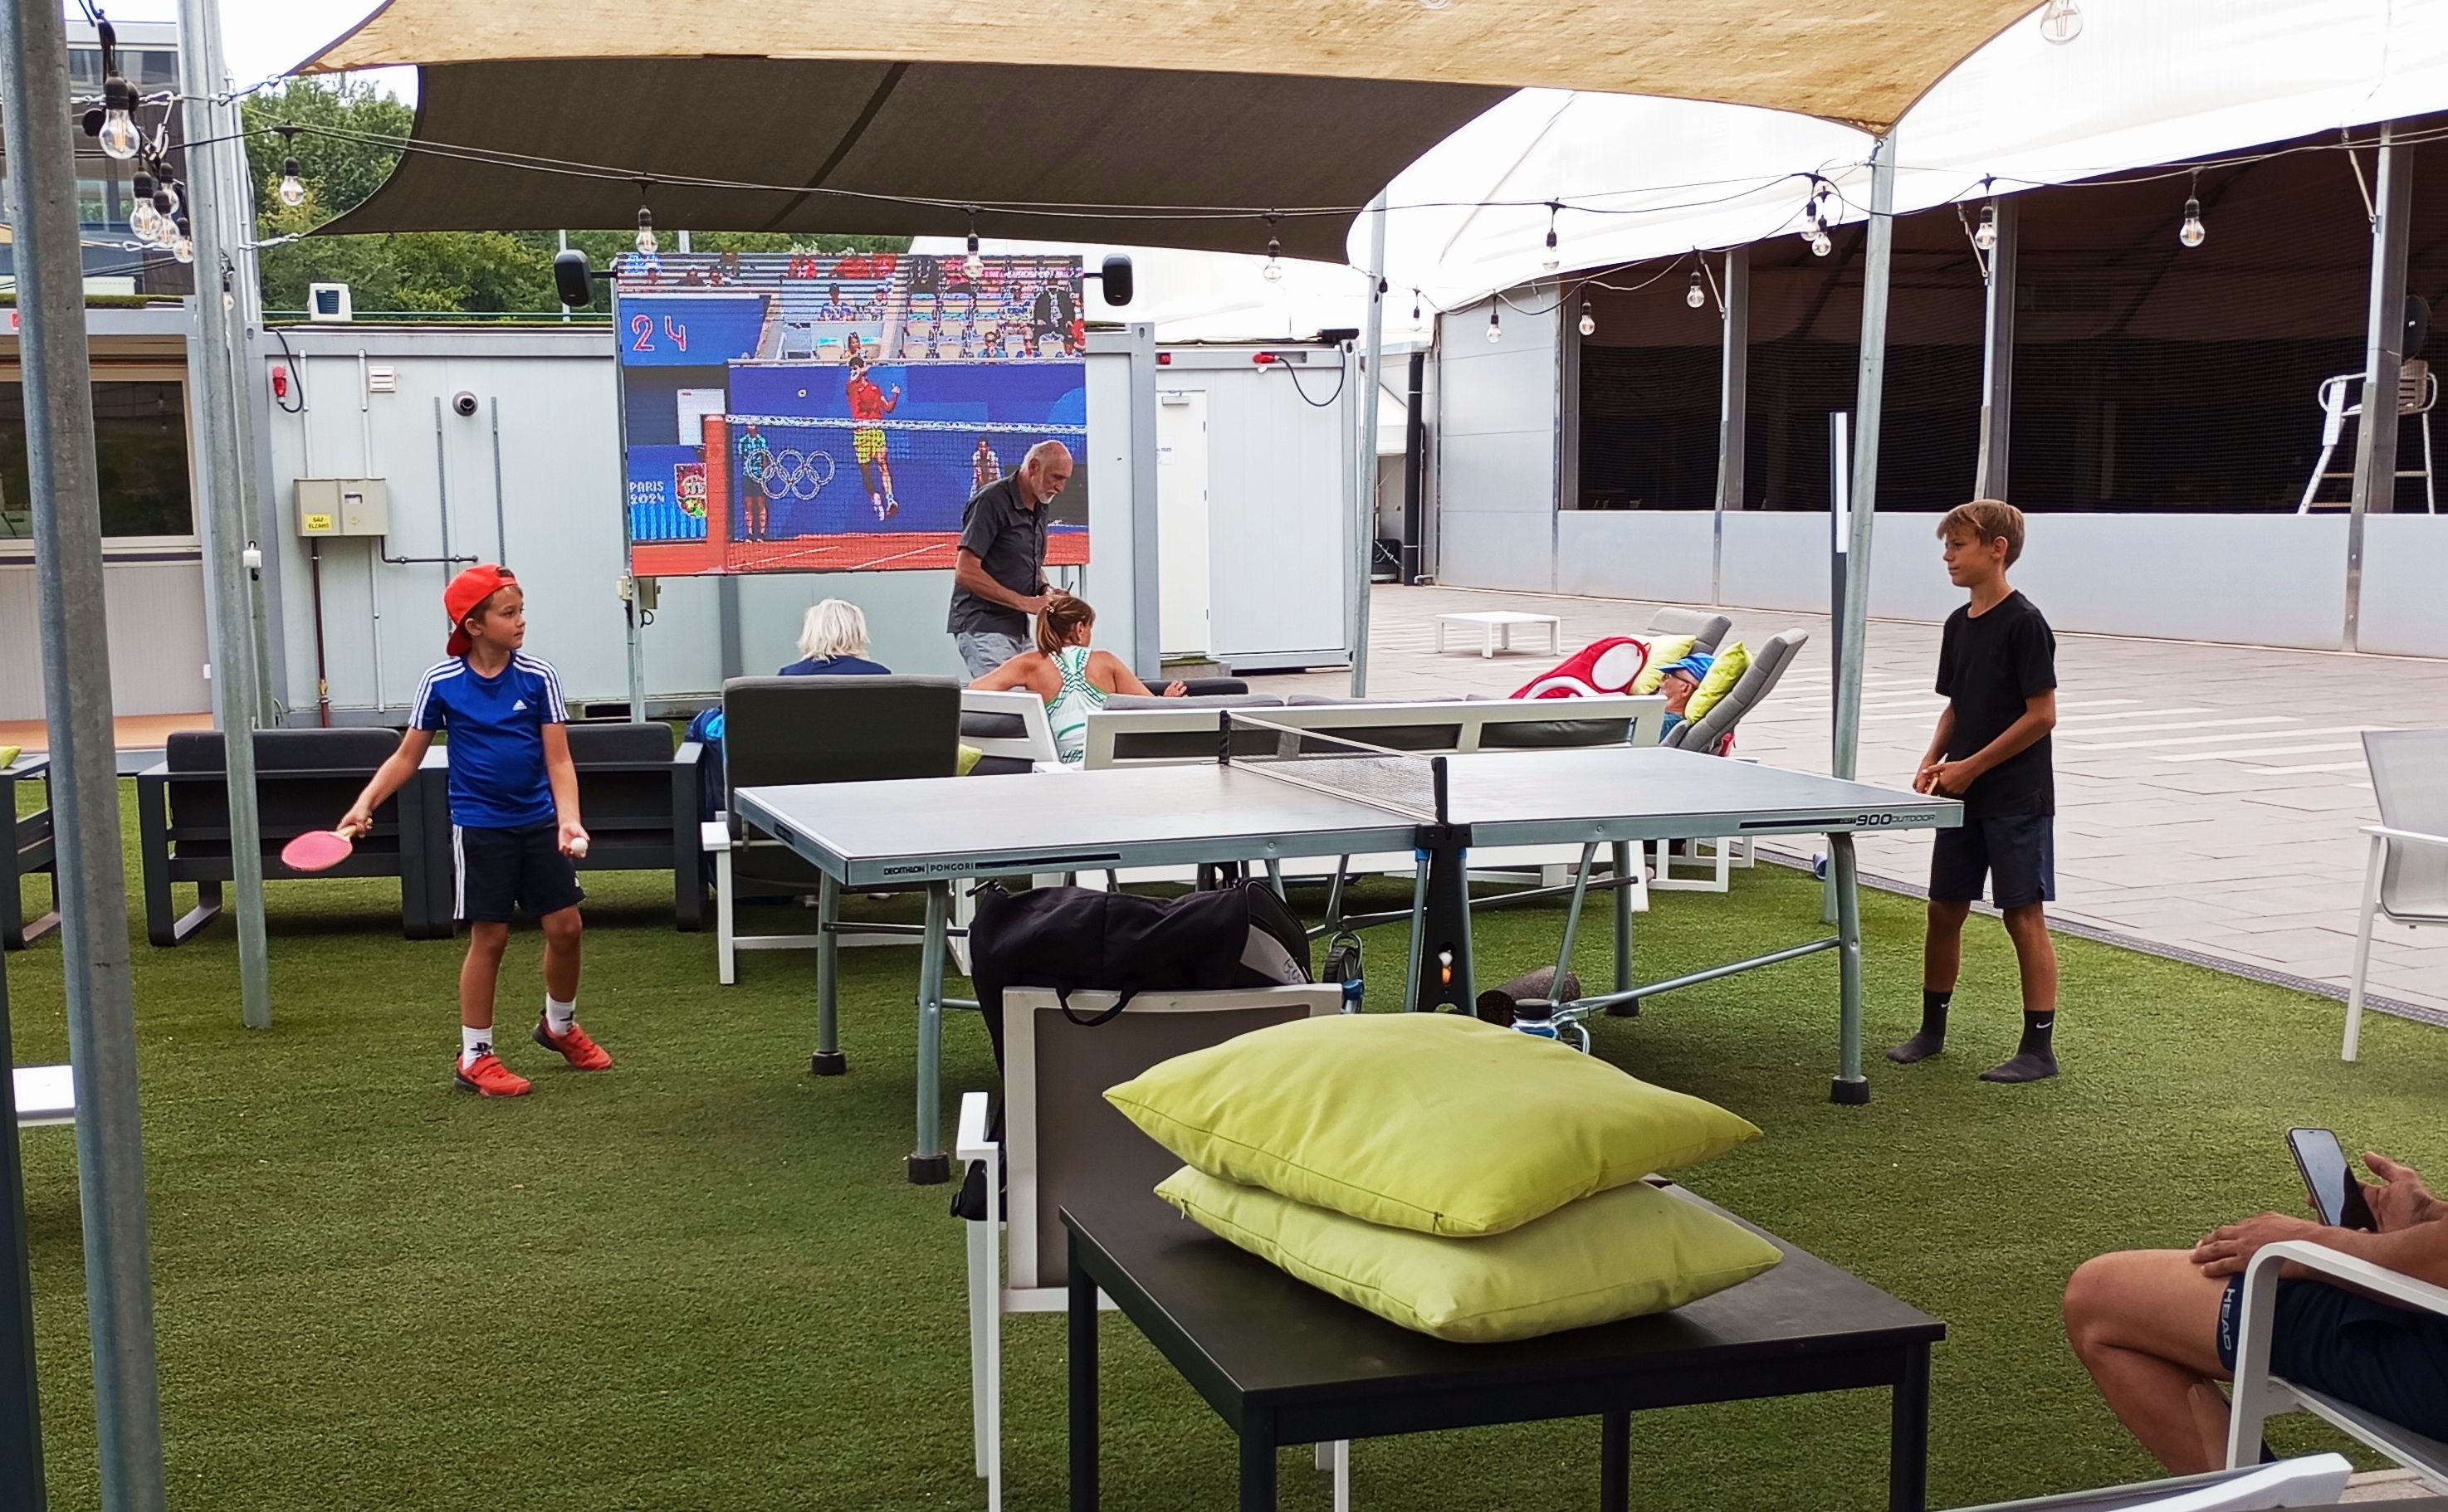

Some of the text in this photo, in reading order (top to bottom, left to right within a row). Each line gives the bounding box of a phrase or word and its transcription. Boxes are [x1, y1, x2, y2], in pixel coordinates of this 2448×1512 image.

[629, 480, 664, 493] PARIS
[630, 493, 665, 505] 2024
[1856, 813, 1893, 826] 900
[1892, 814, 1936, 822] OUTDOOR
[930, 862, 974, 872] PONGORI
[2221, 1288, 2235, 1351] HEAD
